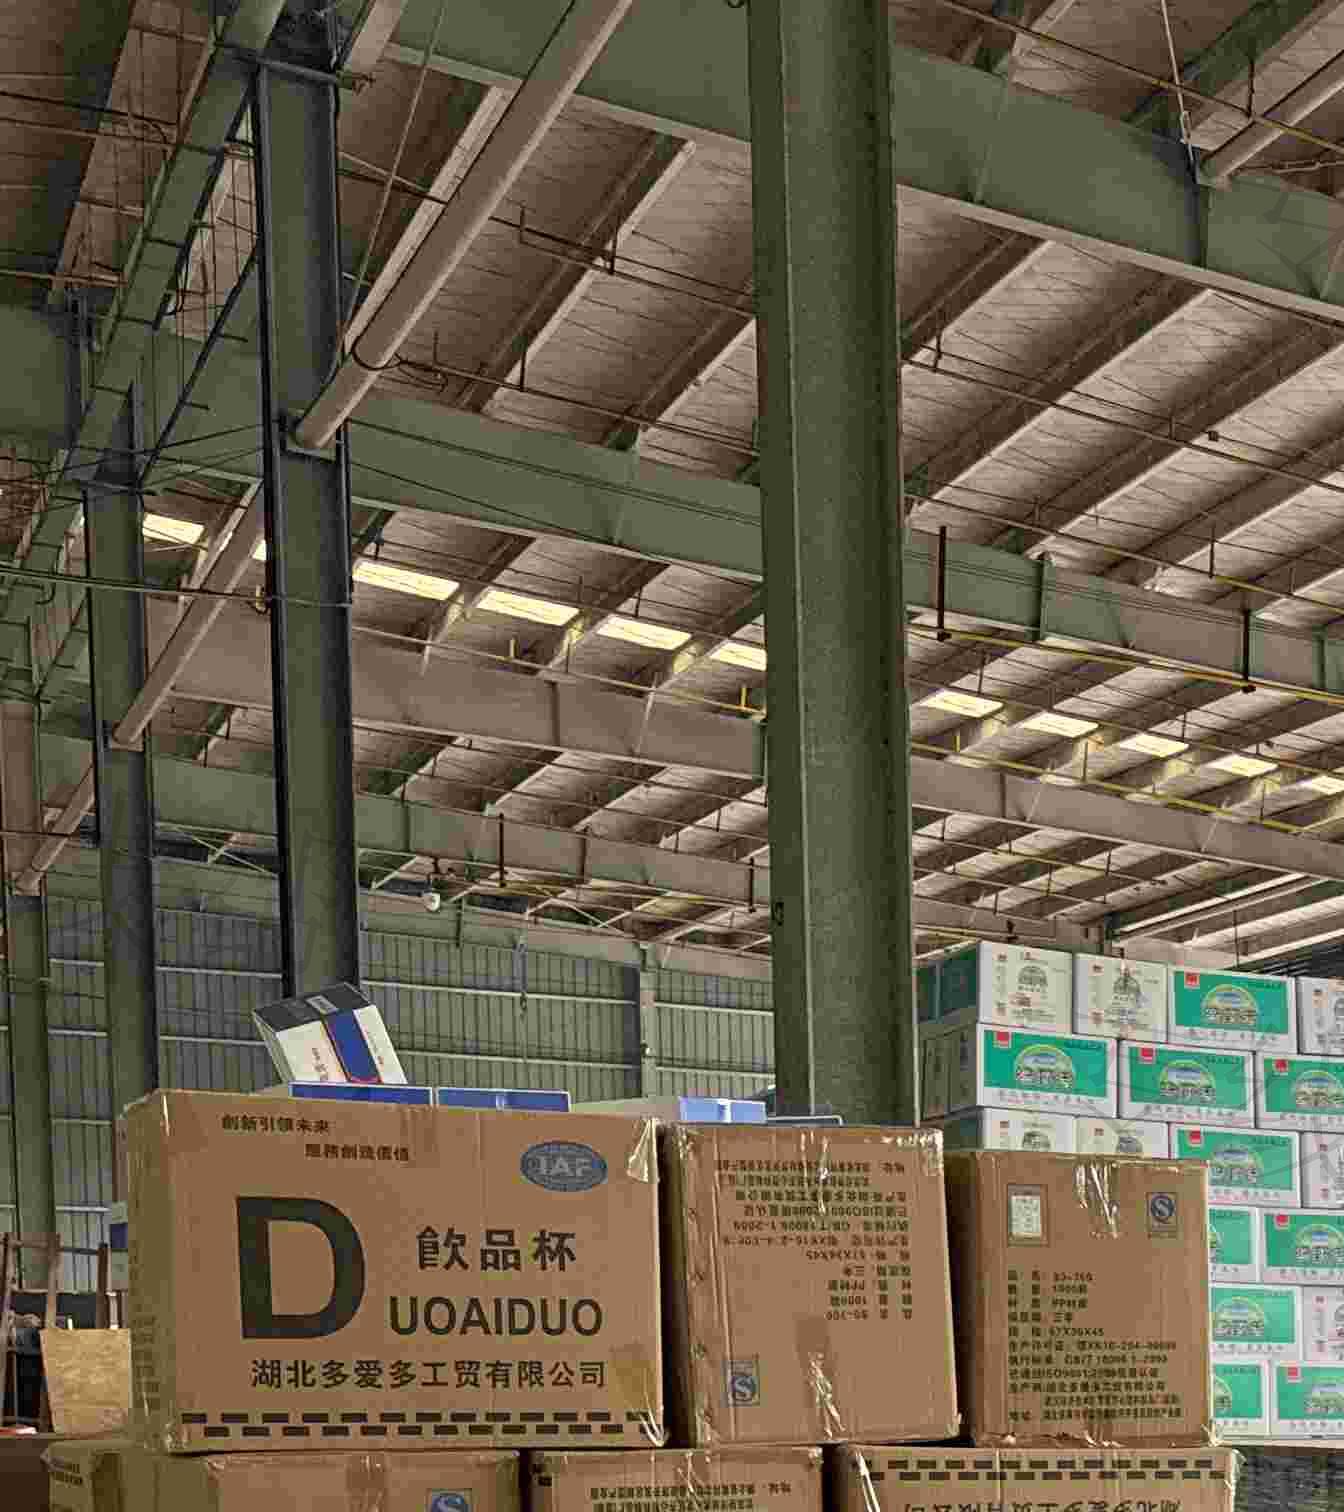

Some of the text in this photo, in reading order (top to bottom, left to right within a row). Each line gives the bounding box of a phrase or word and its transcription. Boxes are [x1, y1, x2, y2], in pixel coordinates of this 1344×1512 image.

[236, 1195, 366, 1340] D
[388, 1296, 603, 1337] UOAIDUO
[251, 1358, 607, 1390] 湖北多爱多工贸有限公司
